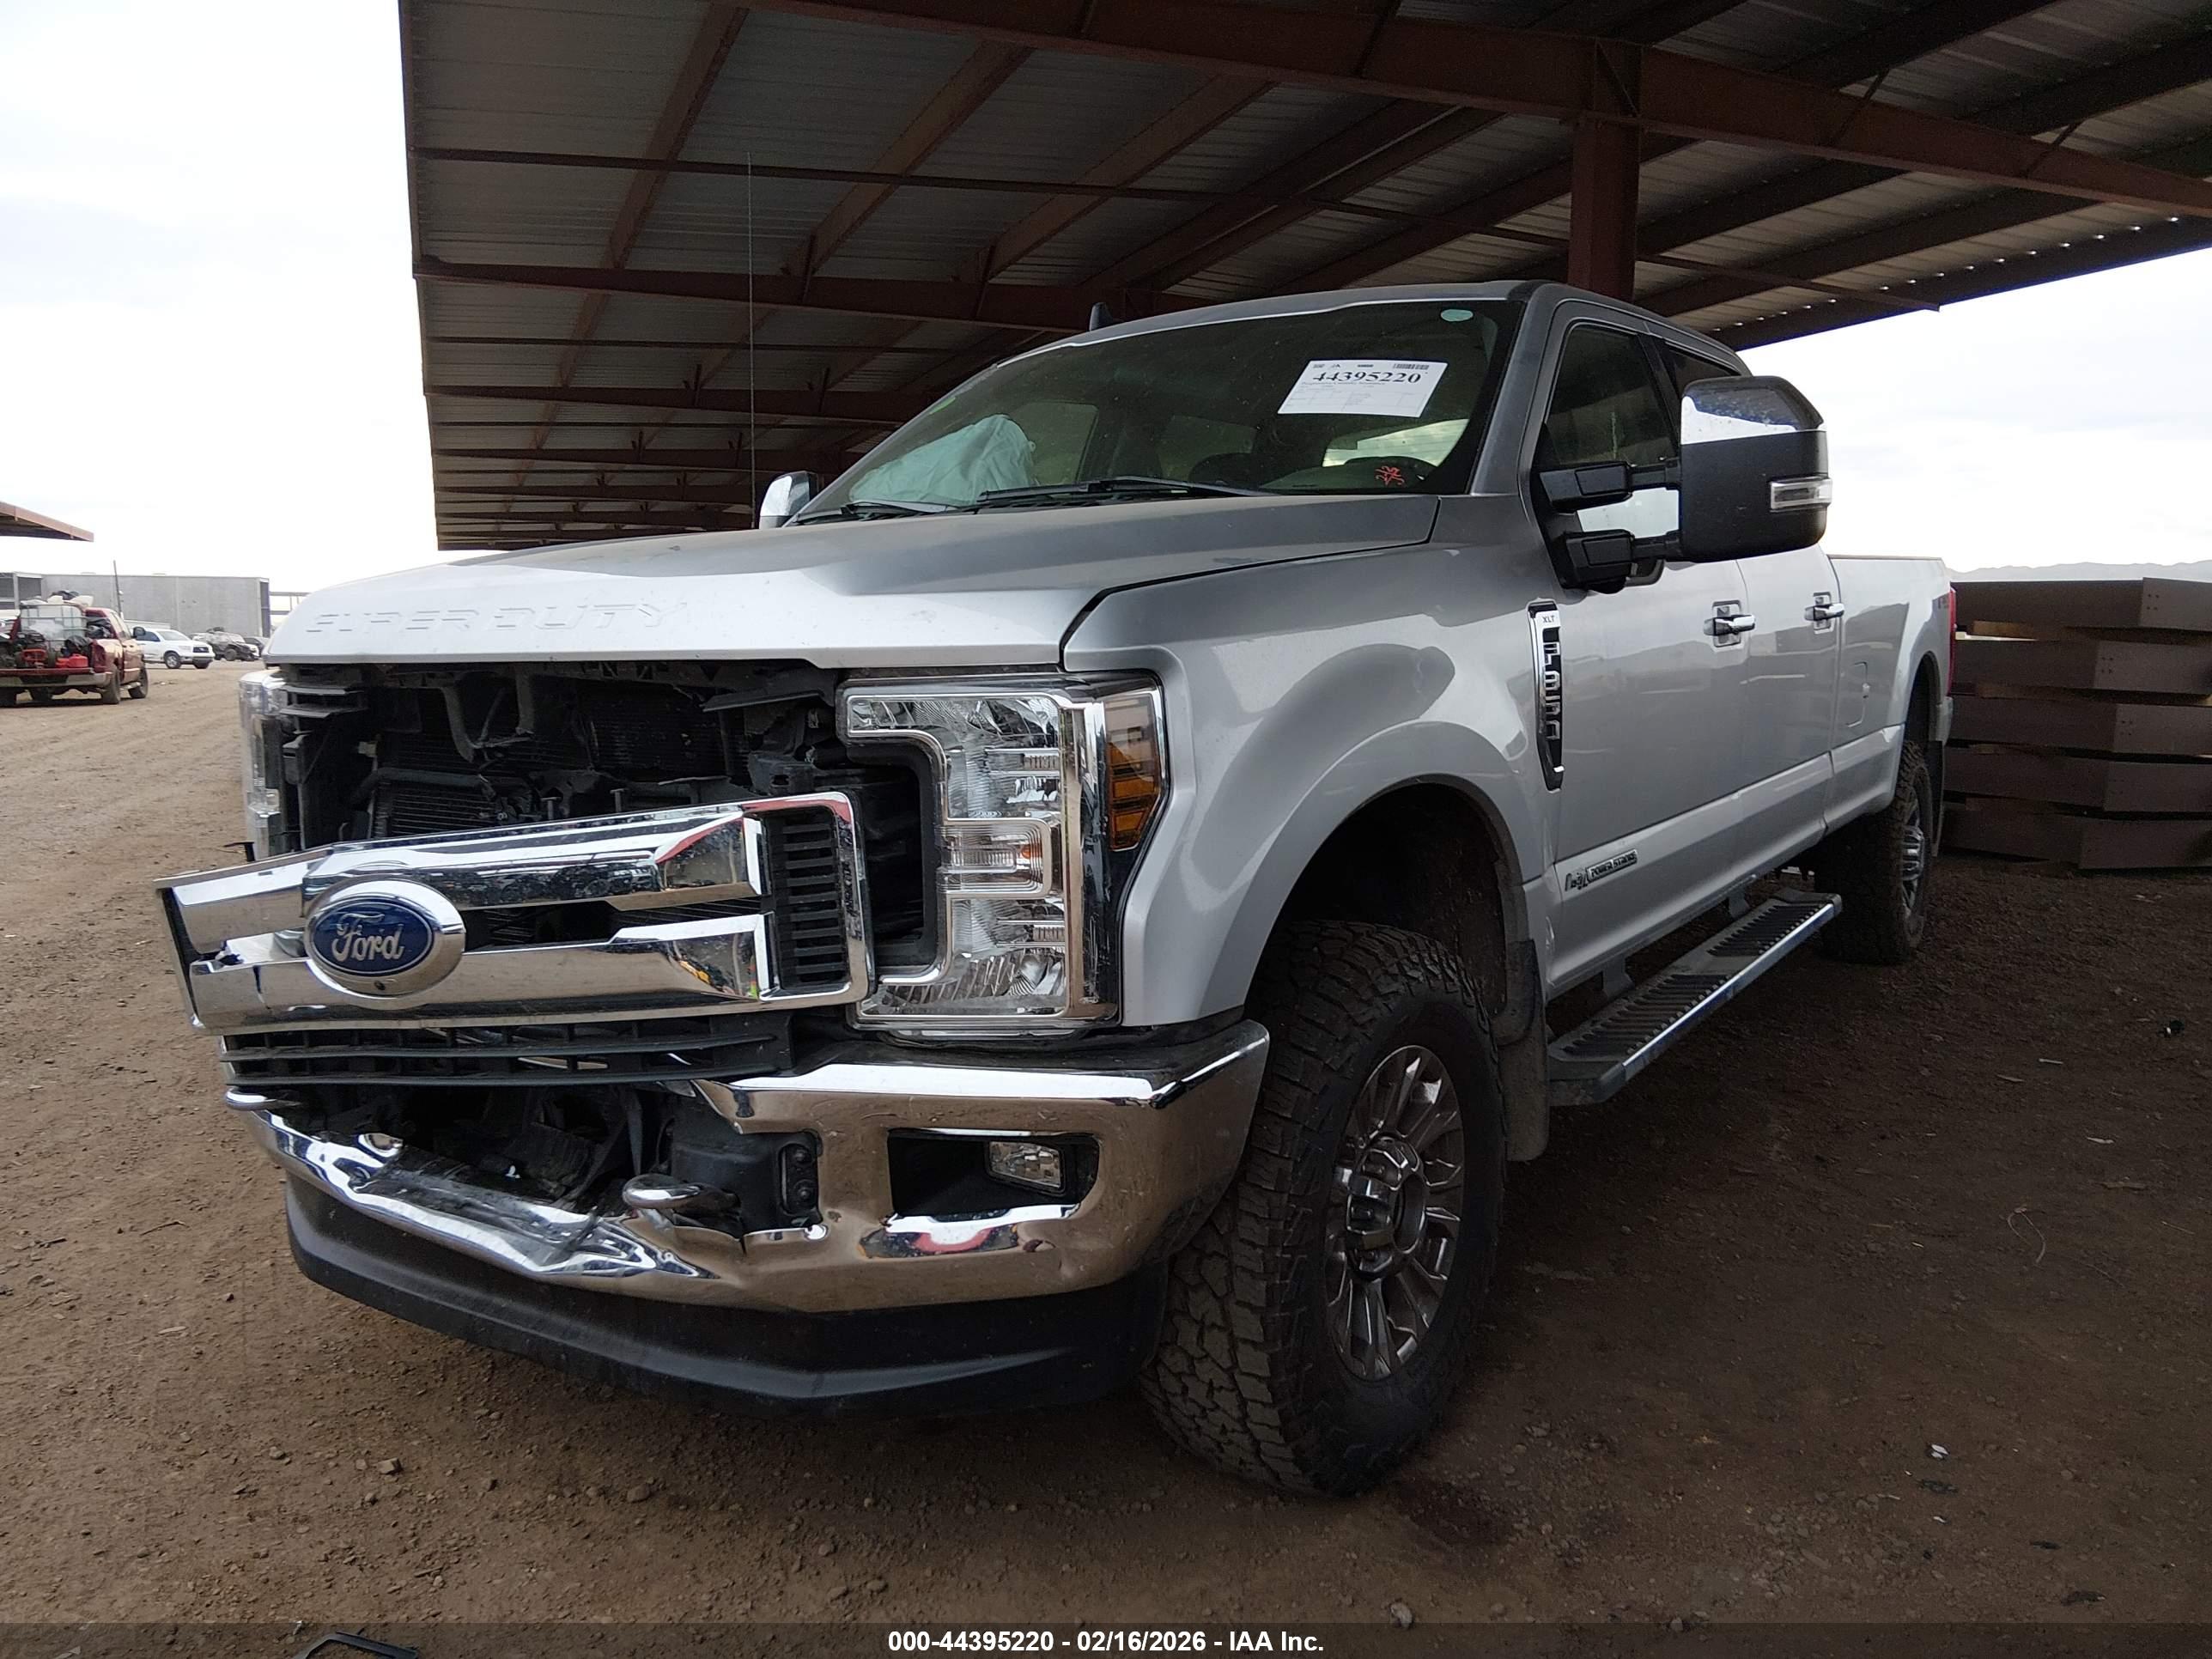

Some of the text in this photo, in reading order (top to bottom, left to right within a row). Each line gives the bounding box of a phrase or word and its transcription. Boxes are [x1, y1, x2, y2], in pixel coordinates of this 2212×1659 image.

[1313, 371, 1421, 383] 44395220
[306, 602, 688, 633] SUPER DUTY
[1542, 615, 1555, 623] XLT
[331, 911, 405, 962] Ford
